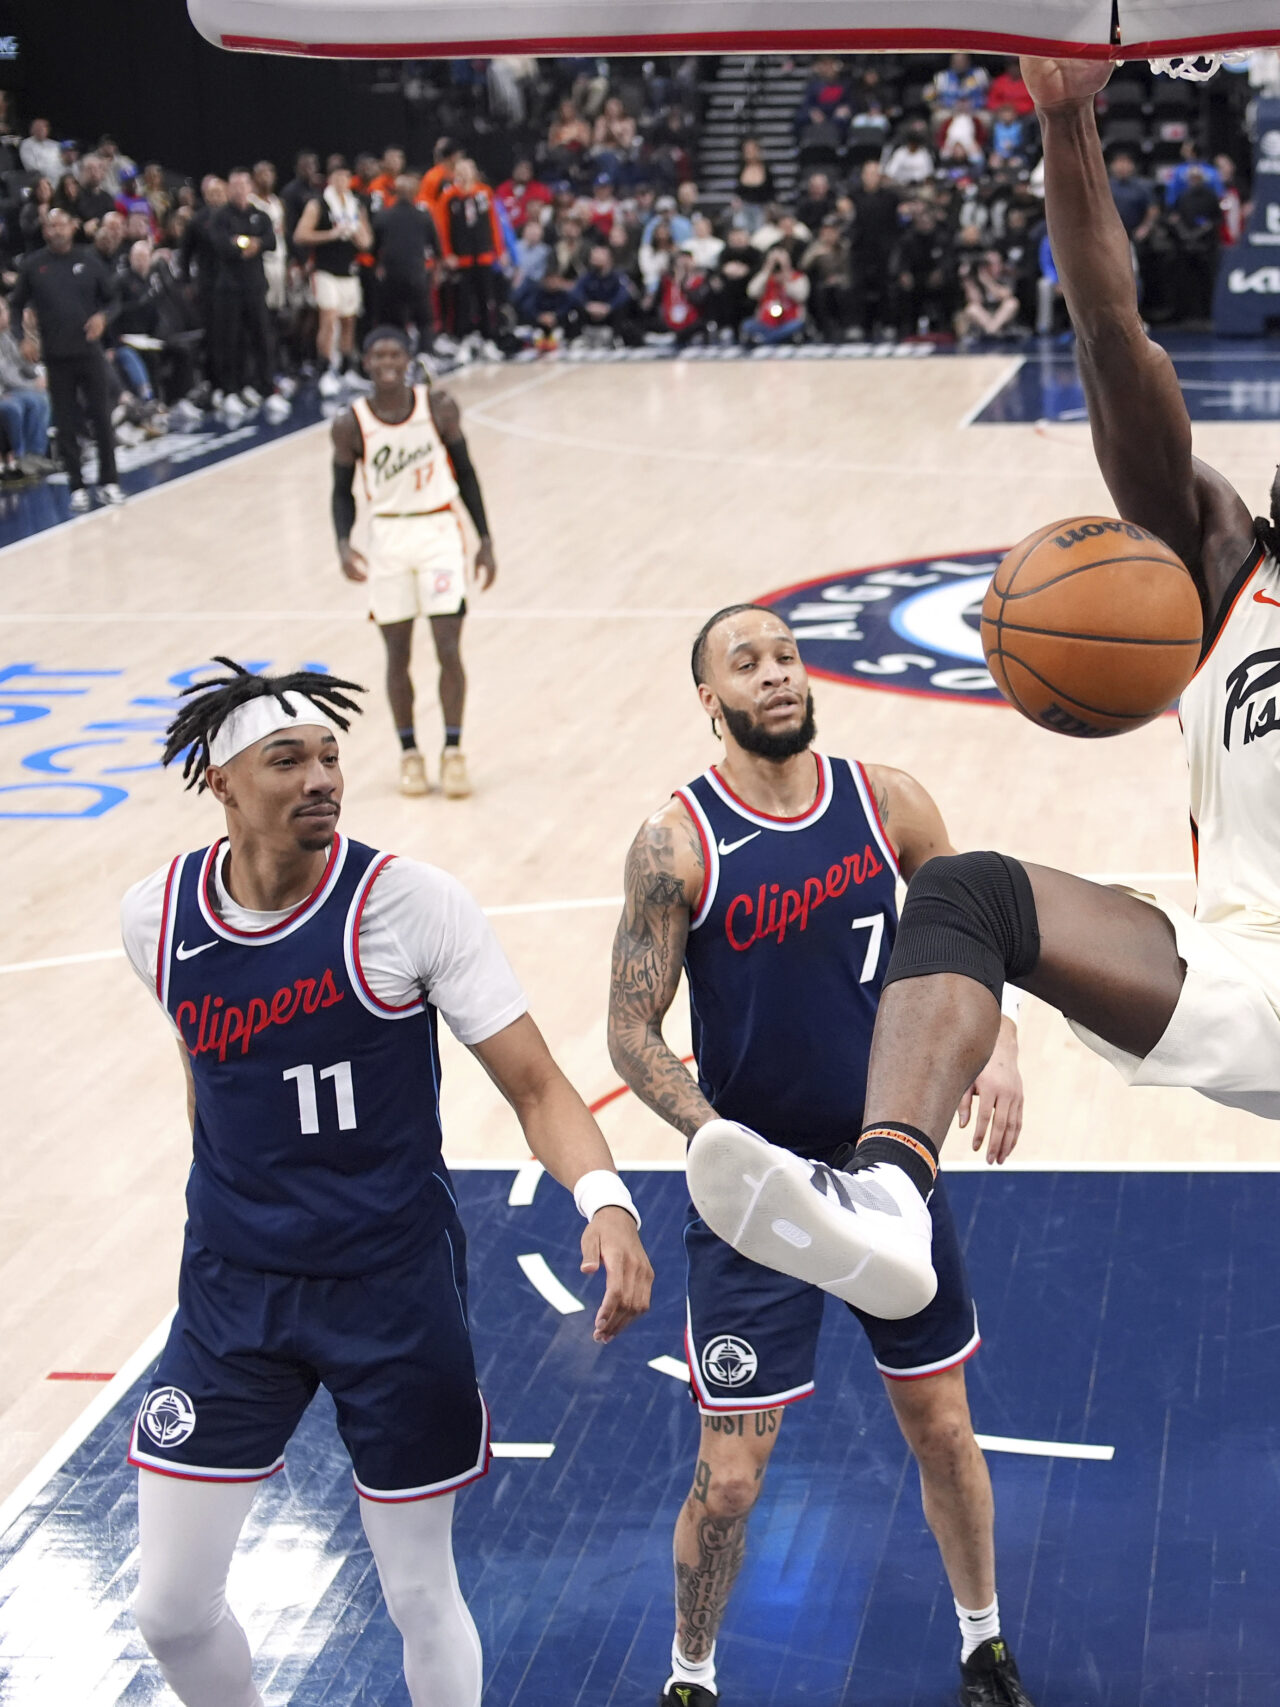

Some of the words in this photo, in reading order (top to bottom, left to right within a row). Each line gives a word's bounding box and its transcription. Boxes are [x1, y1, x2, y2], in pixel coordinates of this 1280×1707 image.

[372, 444, 433, 486] Pistons
[413, 461, 435, 491] 17
[725, 844, 884, 952] Clippers
[851, 912, 885, 983] 7
[176, 968, 344, 1062] Clippers
[282, 1061, 358, 1134] 11
